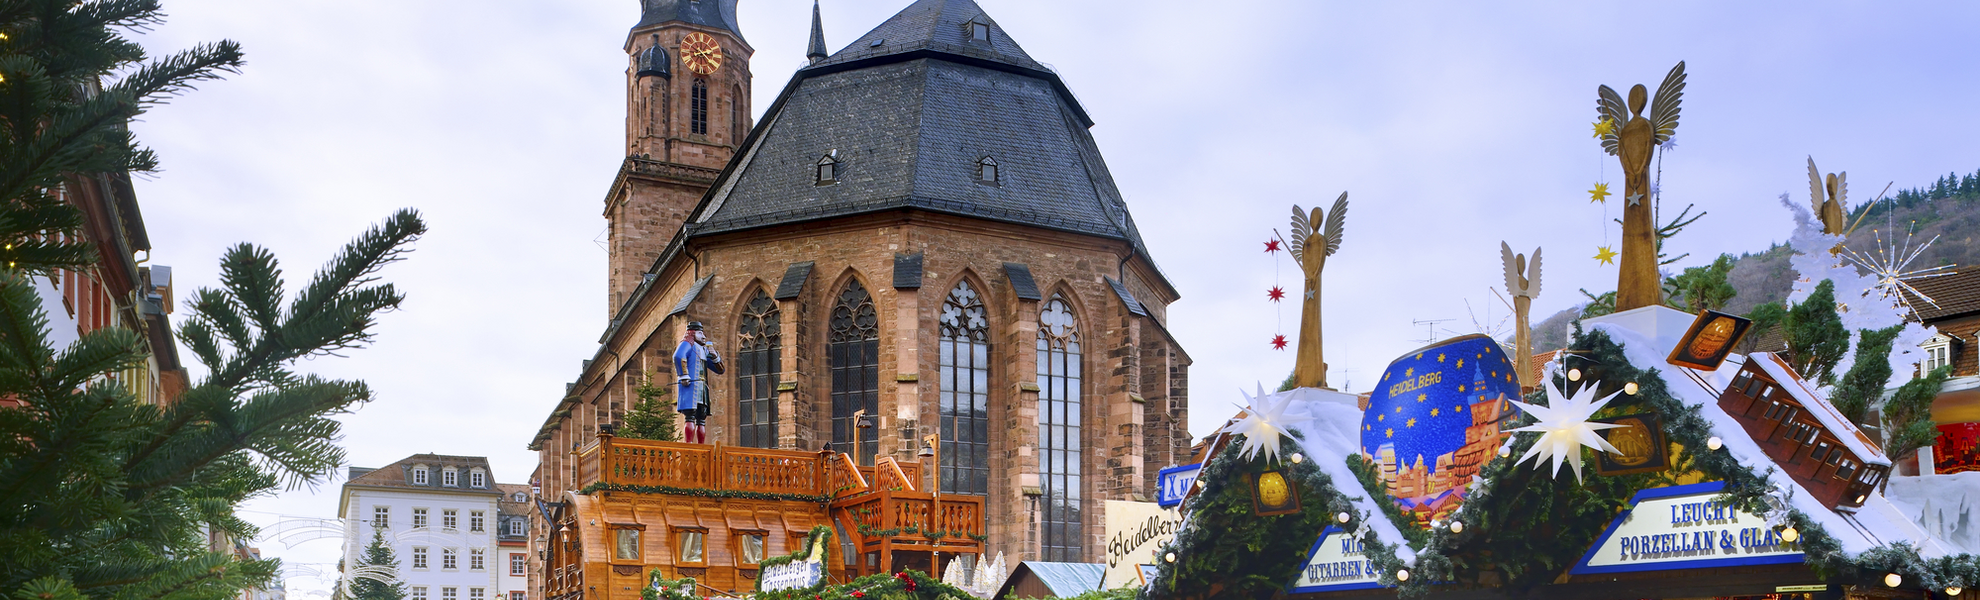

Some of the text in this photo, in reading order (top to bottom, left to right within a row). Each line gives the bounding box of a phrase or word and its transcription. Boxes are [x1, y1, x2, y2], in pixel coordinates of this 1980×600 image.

[1388, 371, 1442, 400] HEIDELBERG
[1620, 530, 1715, 556] PORZELLAN
[1719, 529, 1734, 550] &
[1308, 560, 1362, 580] GITARREN
[1364, 559, 1374, 575] &
